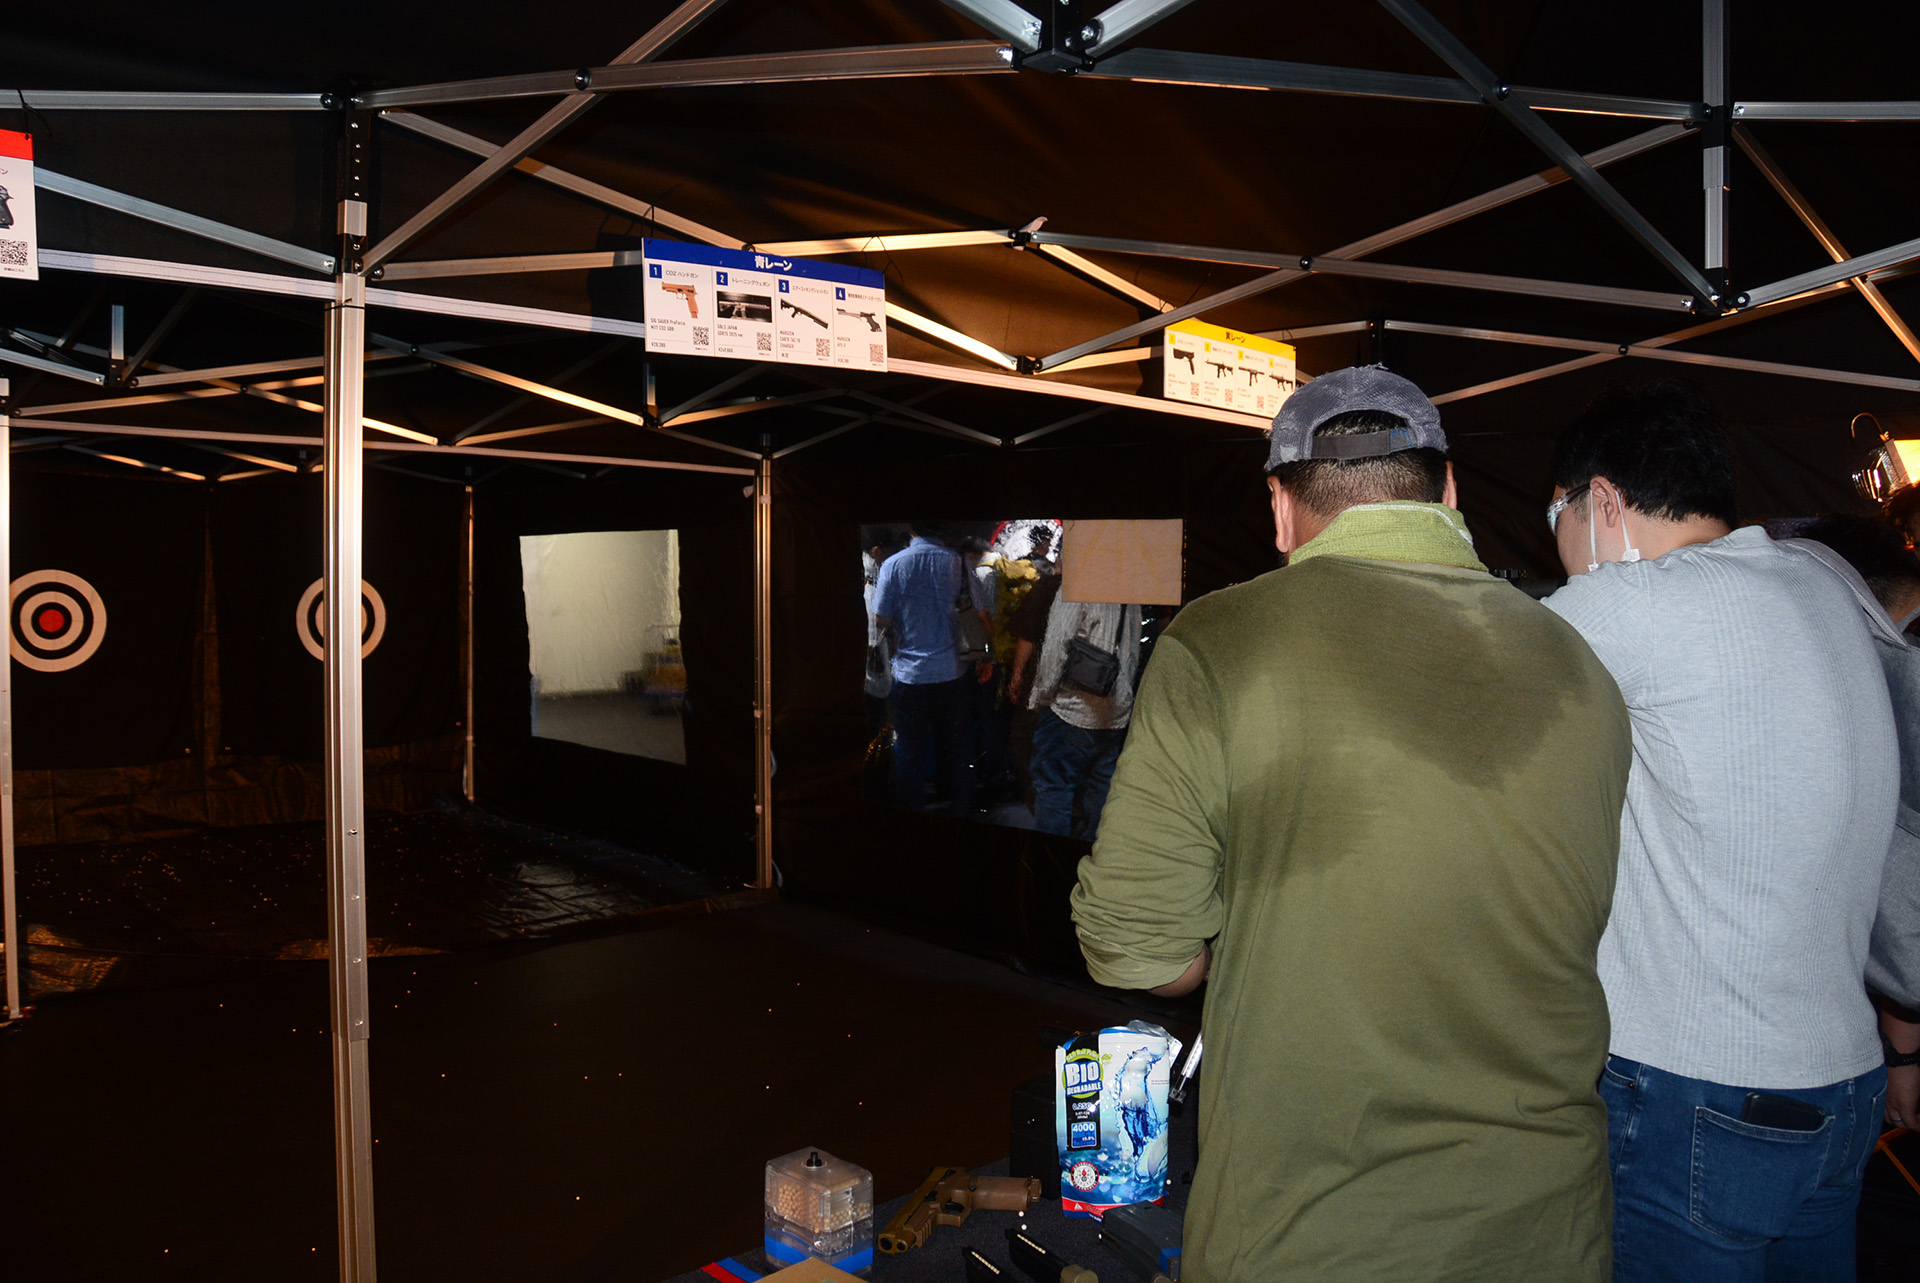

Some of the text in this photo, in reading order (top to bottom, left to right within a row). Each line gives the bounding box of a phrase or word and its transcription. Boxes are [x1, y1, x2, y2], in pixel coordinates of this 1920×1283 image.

[755, 255, 792, 271] 青レーン
[653, 267, 658, 275] 1
[720, 274, 725, 283] 2
[781, 282, 786, 290] 3
[838, 291, 843, 299] 4
[1225, 331, 1247, 343] 黄レーン
[1065, 1061, 1099, 1087] BIO
[1067, 1081, 1102, 1095] DEGRADABLE
[1072, 1123, 1095, 1132] 4000
